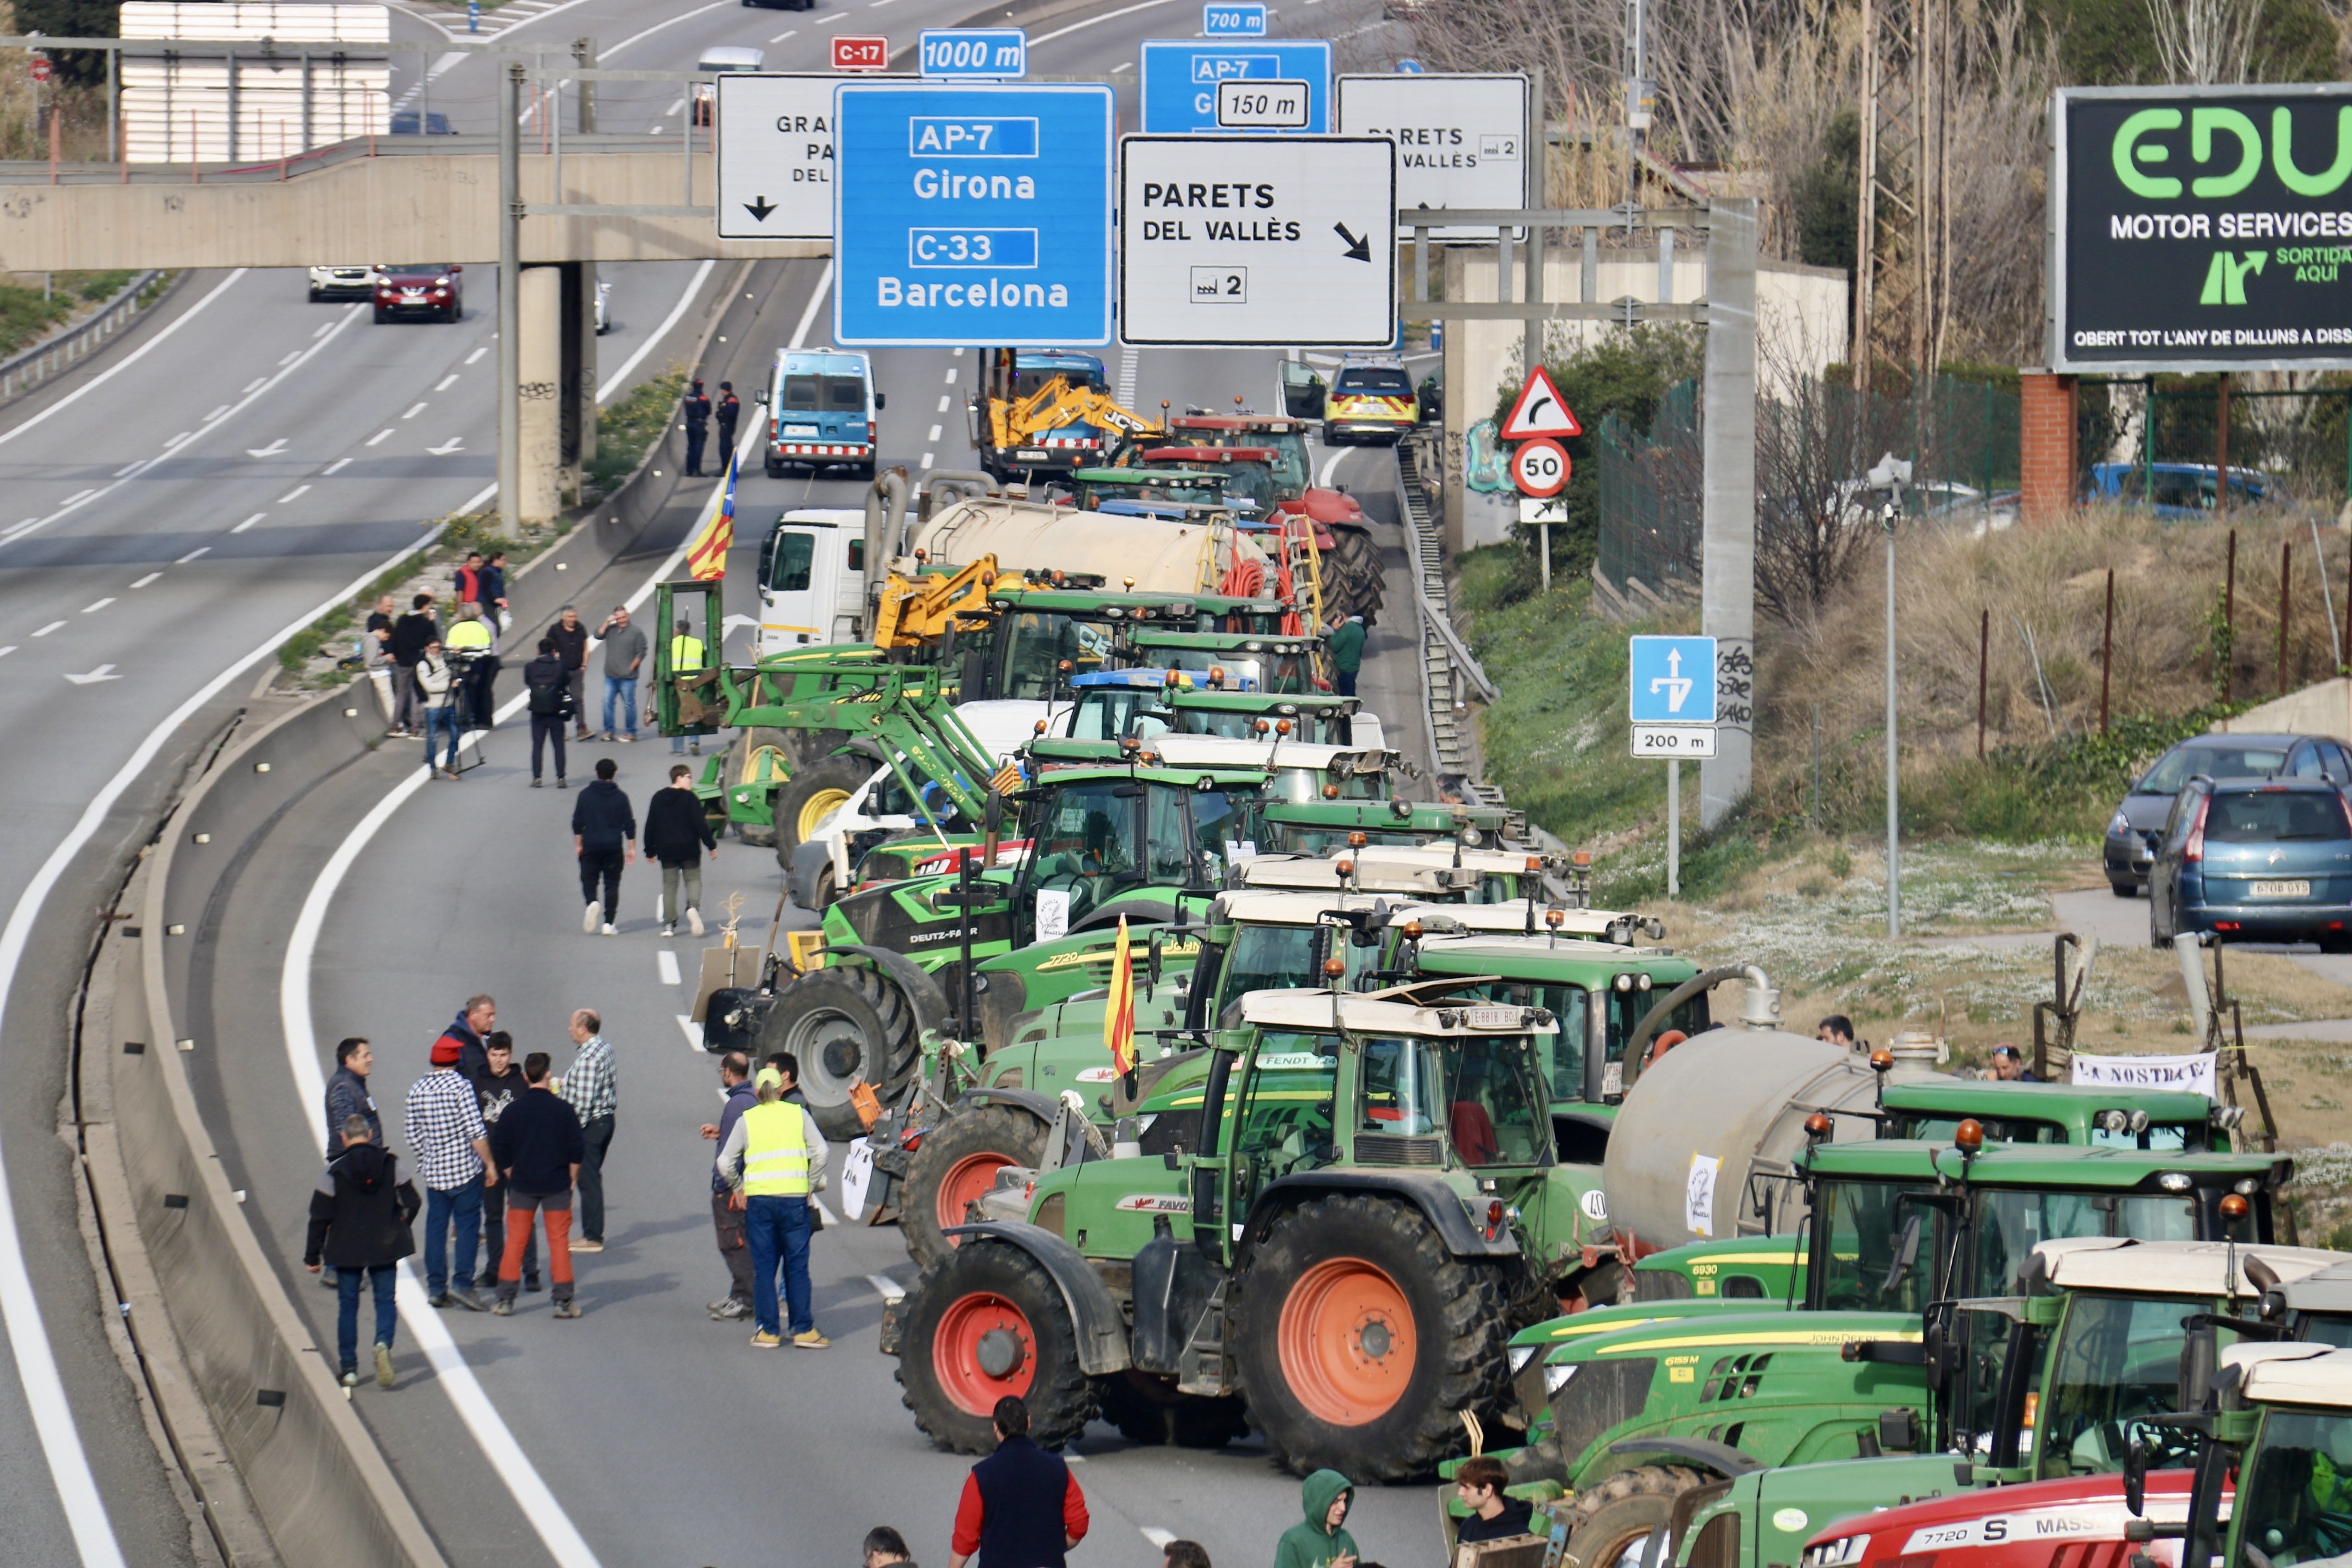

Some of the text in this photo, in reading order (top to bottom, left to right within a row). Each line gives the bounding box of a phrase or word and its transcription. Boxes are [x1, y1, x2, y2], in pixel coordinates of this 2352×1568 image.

[1210, 12, 1261, 28] 700 m
[840, 46, 879, 61] C-17
[925, 42, 1020, 68] 1000 m
[1198, 60, 1249, 79] AP-7
[1232, 94, 1295, 115] 150 m
[777, 116, 834, 133] GRA
[918, 125, 993, 151] AP-7
[1369, 128, 1463, 145] RETS
[1504, 141, 1515, 154] 2
[1403, 151, 1477, 167] VALLÈS
[793, 168, 829, 182] DEL
[913, 168, 1035, 199] Girona
[1144, 183, 1275, 208] PARETS
[1144, 216, 1301, 241] DEL VALLÈS
[2111, 213, 2352, 239] MOTOR SERVICES
[917, 235, 992, 260] C-33
[2276, 247, 2352, 265] SORTIDA
[878, 277, 1068, 307] Barcelona
[1227, 275, 1242, 294] 2
[2074, 331, 2126, 346] OBERT
[2129, 331, 2160, 346] TOT
[2164, 330, 2208, 346] L'ANY
[2211, 330, 2232, 346] DE
[2235, 329, 2299, 346] DILLUNS
[2301, 329, 2313, 345] A
[1526, 458, 1558, 477] 50
[1645, 734, 1705, 748] 200 m
[910, 927, 978, 944] DEUTZ-FAR
[1050, 952, 1079, 965] 7720
[2079, 1061, 2100, 1080] LA
[2110, 1067, 2184, 1083] NOSTRA
[1590, 1193, 1607, 1217] 40
[1693, 1265, 1718, 1275] 6930
[1809, 1333, 1839, 1344] JOHN
[1924, 1528, 1968, 1545] 7720
[1983, 1518, 2007, 1540] S
